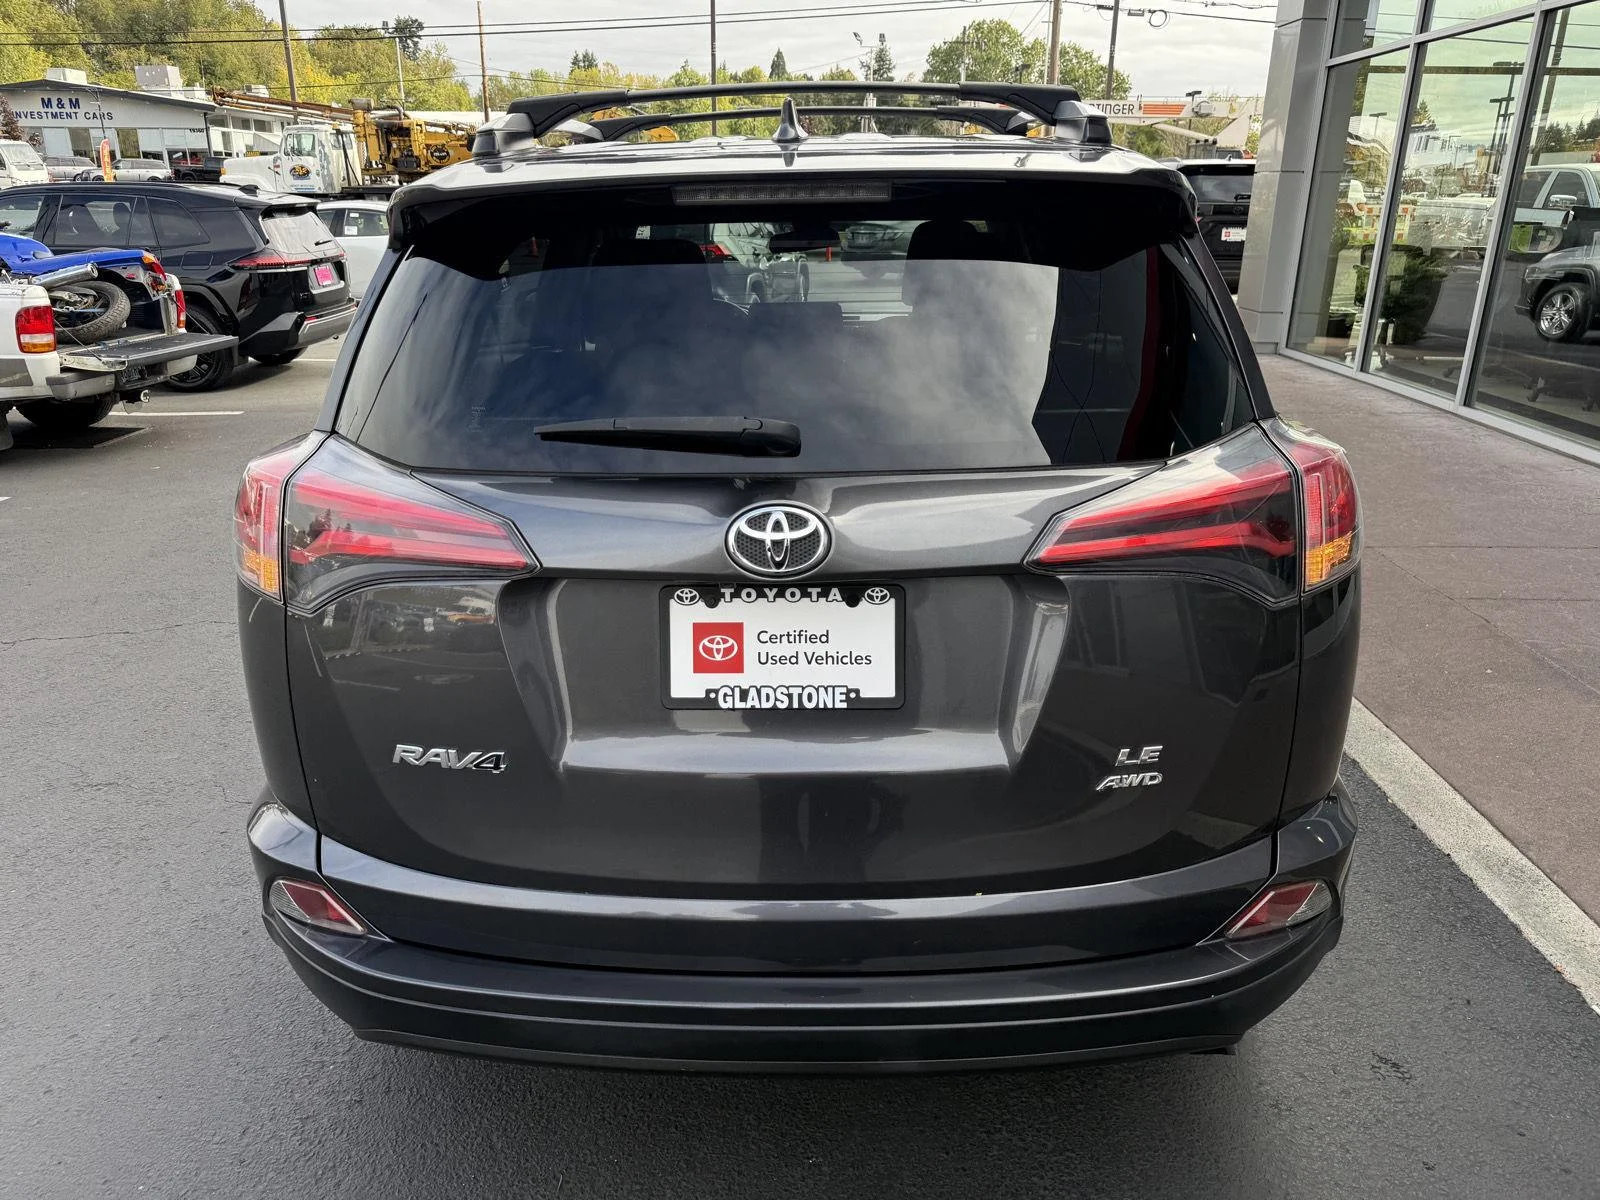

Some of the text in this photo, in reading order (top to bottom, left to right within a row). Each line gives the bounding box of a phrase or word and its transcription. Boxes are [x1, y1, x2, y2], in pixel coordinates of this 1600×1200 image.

[40, 97, 80, 109] M & M
[83, 111, 114, 121] CARS
[720, 587, 843, 603] TOYOTA
[757, 630, 830, 644] Certified
[757, 651, 872, 666] Used Vehicles
[717, 685, 848, 709] GLADSTONE
[392, 744, 506, 774] RAV4
[1115, 745, 1163, 766] LE
[1096, 772, 1163, 790] AWD
